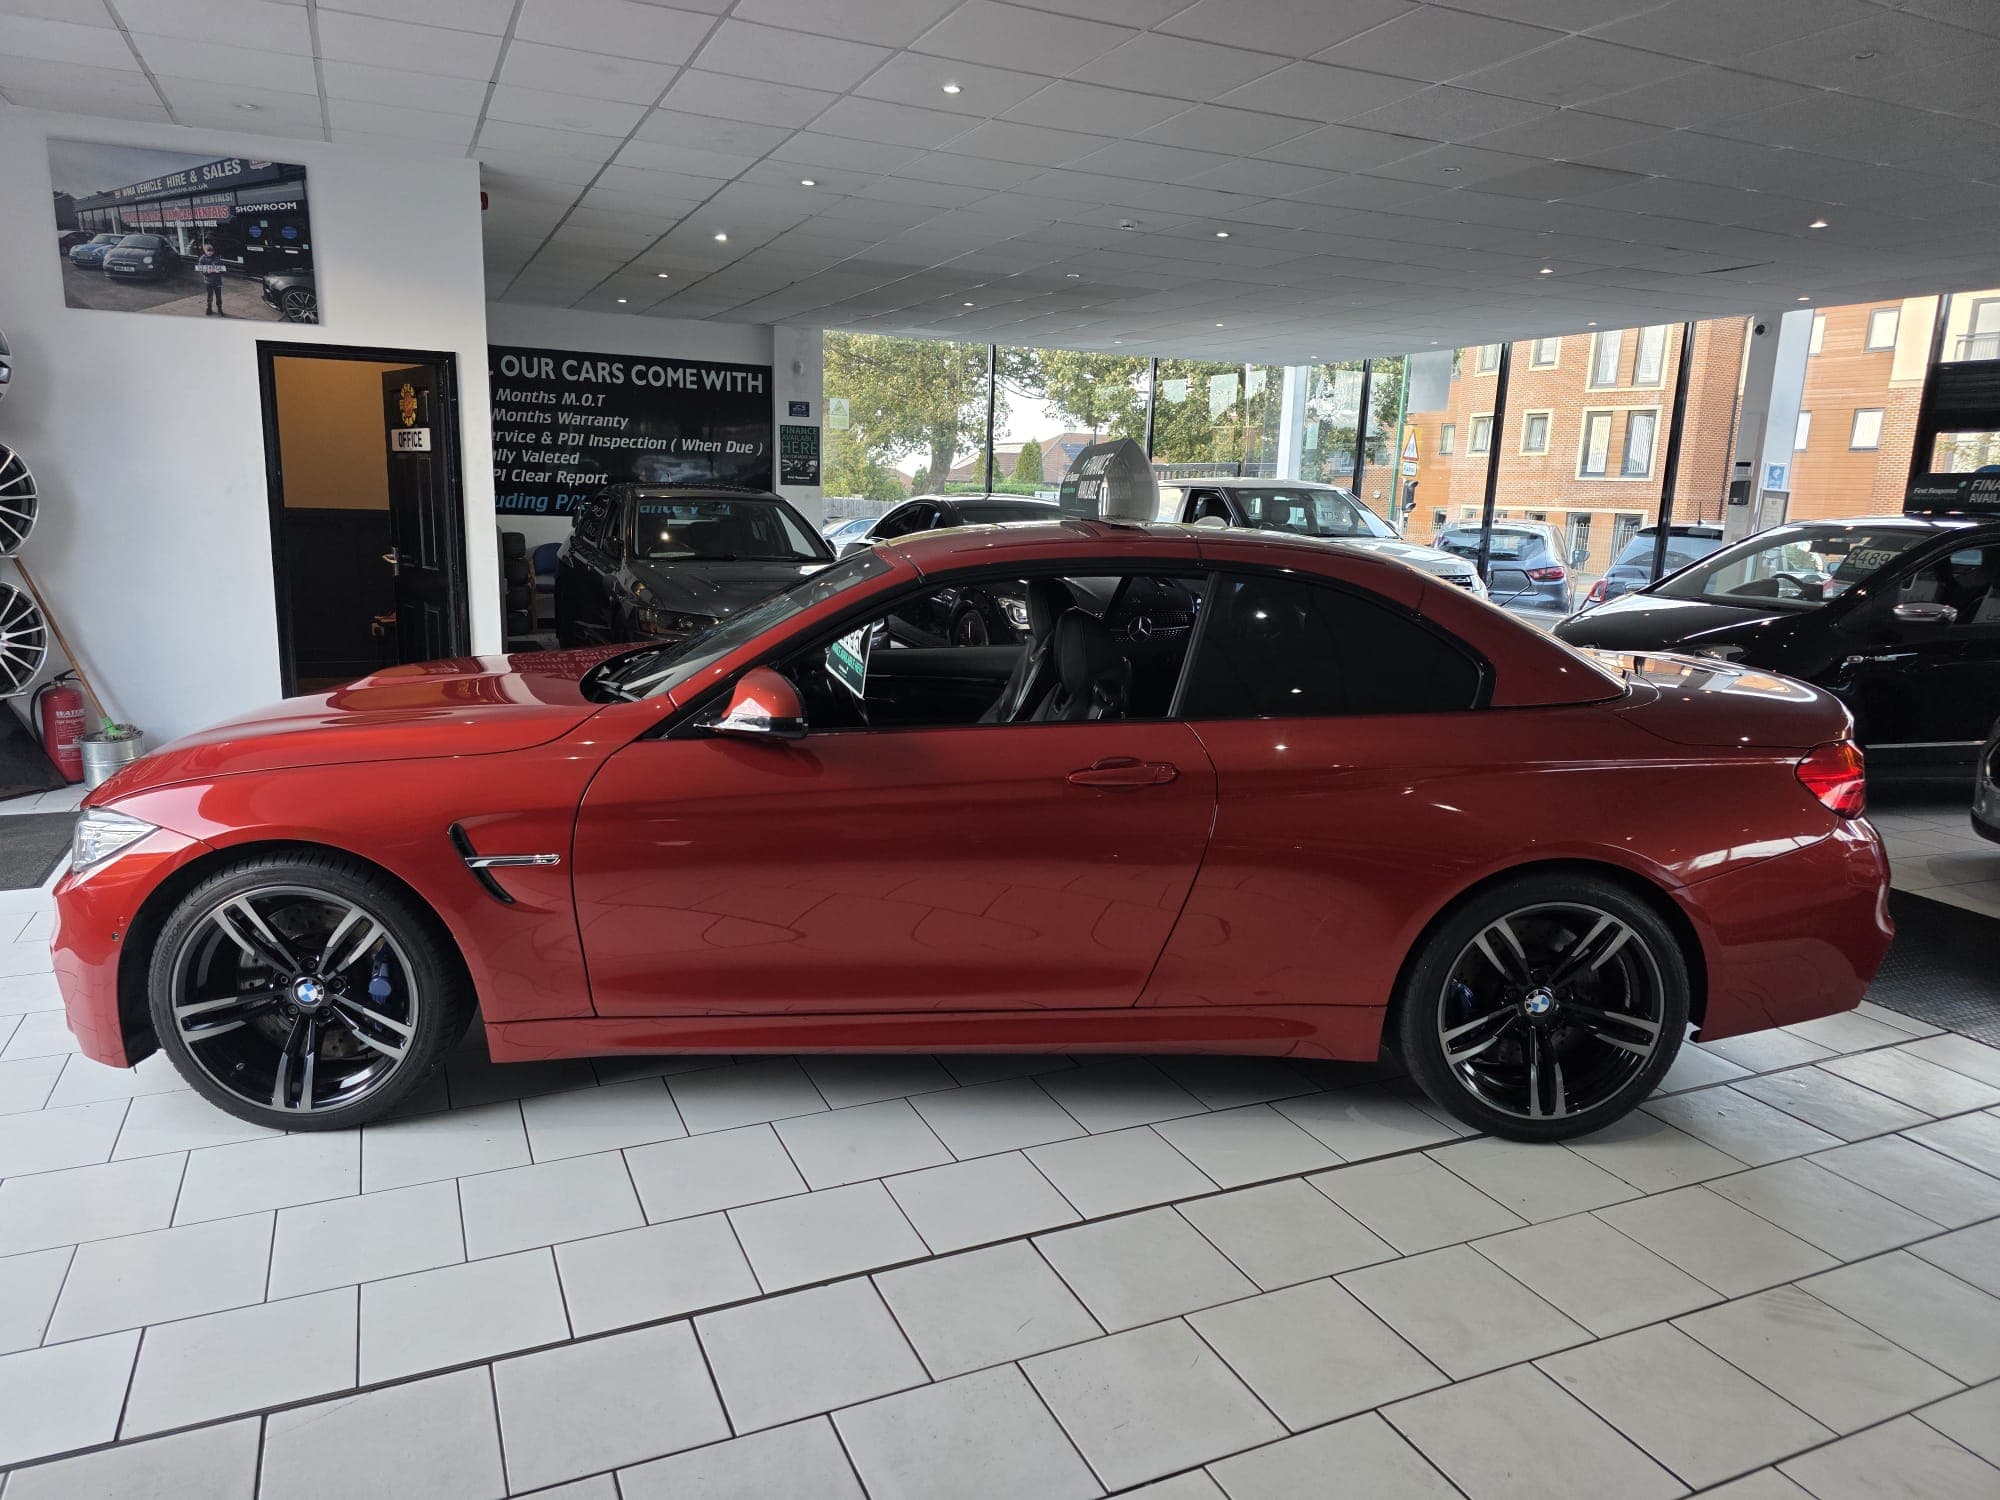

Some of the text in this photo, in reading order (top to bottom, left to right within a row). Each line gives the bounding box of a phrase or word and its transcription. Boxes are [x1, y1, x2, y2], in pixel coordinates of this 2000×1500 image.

[136, 179, 162, 195] VEHICLE
[166, 171, 187, 188] HIRE
[190, 170, 198, 183] &
[202, 159, 242, 180] SALES
[235, 202, 297, 213] SHOWROOM
[500, 355, 763, 394] OUR CARS COME WITH
[495, 388, 606, 407] Months M.O.T
[558, 411, 629, 430] Warranty
[398, 431, 423, 448] OFFICE
[781, 426, 818, 435] FINANCE
[541, 431, 553, 445] &
[557, 432, 585, 446] PDI
[588, 433, 667, 450] Inspection
[682, 438, 721, 452] When
[725, 440, 754, 454] Due
[781, 441, 818, 455] HERE
[522, 449, 580, 465] Valeted
[511, 468, 553, 482] Clear
[556, 470, 609, 487] Report
